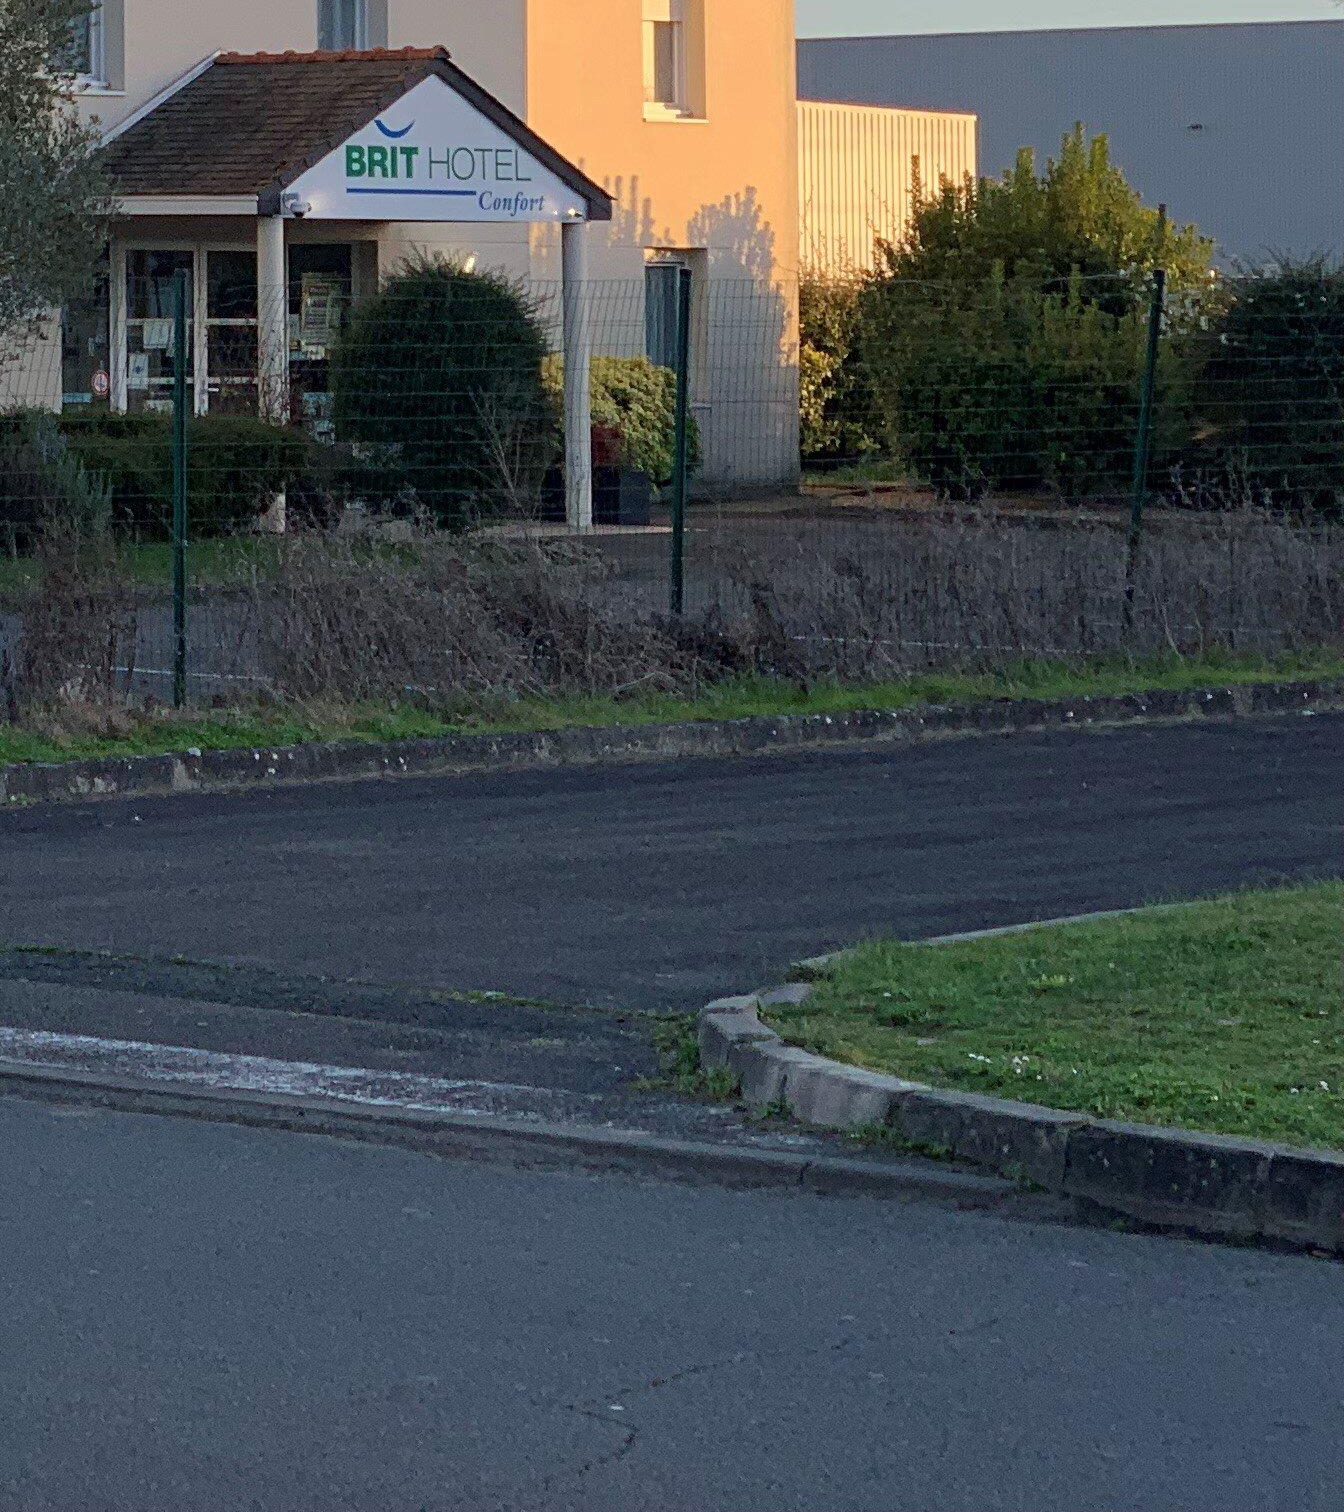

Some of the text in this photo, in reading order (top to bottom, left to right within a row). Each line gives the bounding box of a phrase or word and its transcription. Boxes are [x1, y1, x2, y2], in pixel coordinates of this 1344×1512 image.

[345, 144, 532, 182] BRIT HOTEL
[478, 190, 546, 217] Confort
